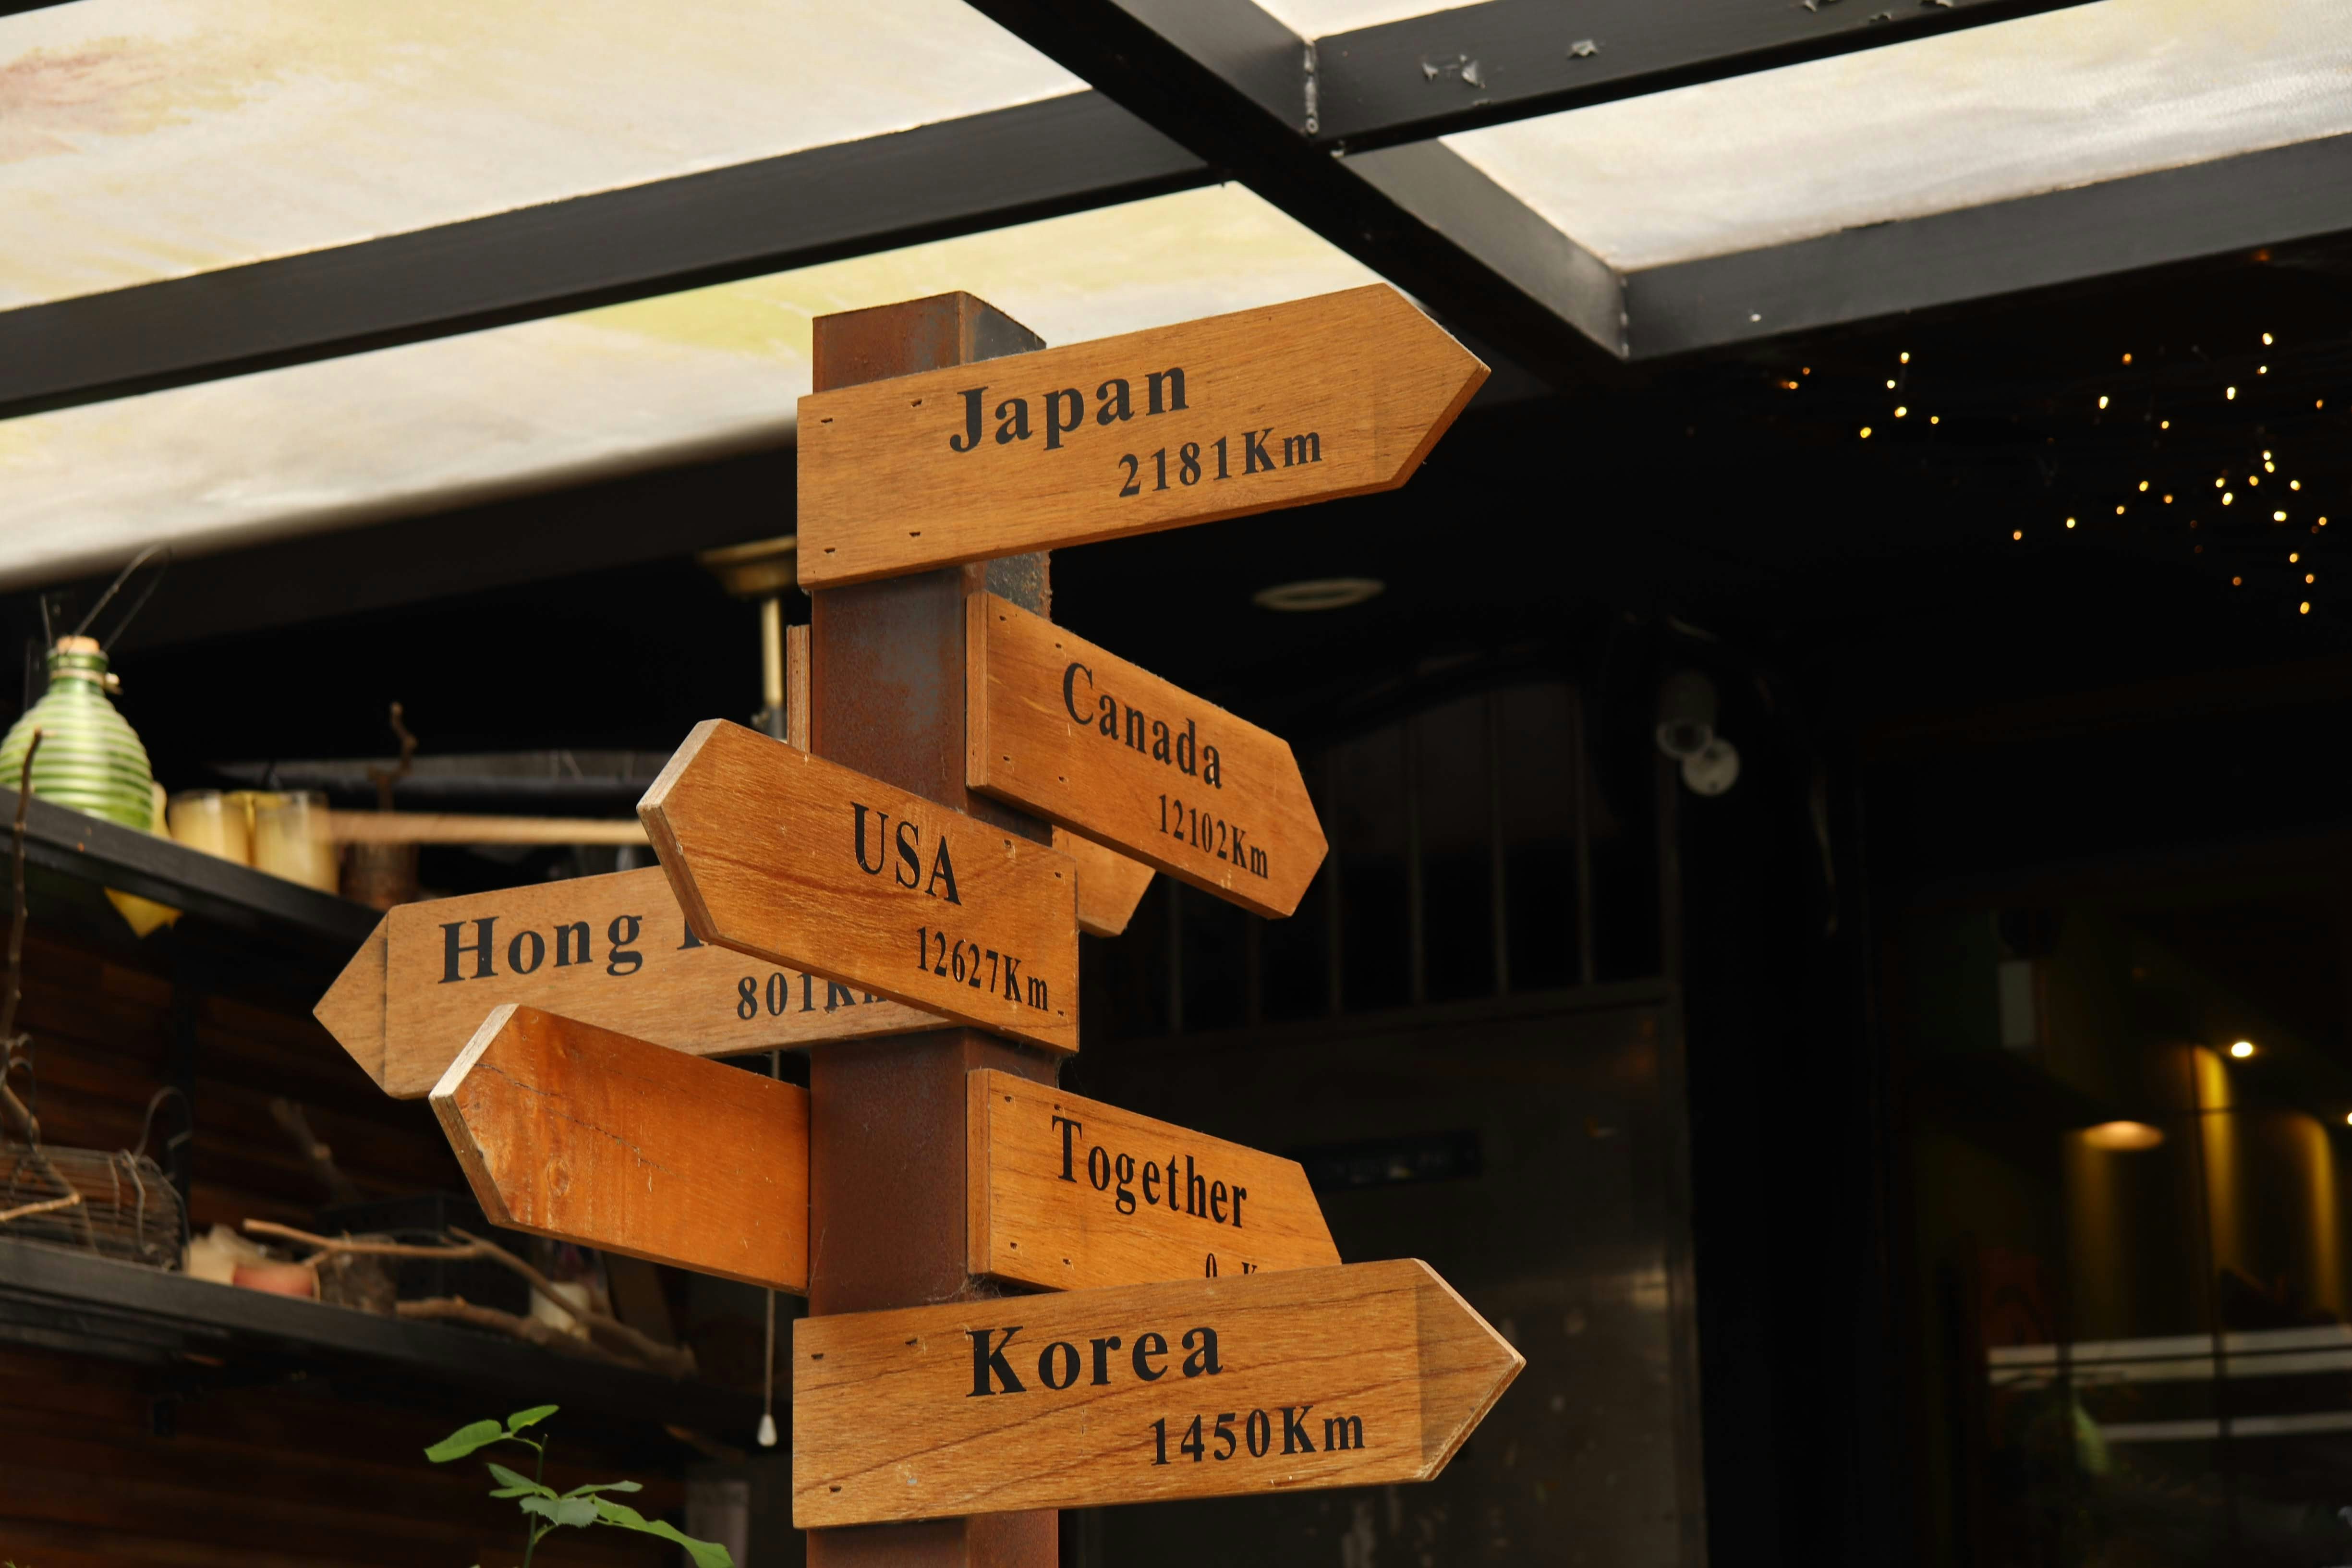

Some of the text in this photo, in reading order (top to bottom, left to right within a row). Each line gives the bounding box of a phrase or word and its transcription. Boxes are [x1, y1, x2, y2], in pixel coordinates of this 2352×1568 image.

[950, 366, 1189, 452] Japan
[1119, 427, 1322, 498] 2181Km
[1063, 662, 1222, 789] Canada
[850, 801, 962, 906] USA
[1159, 794, 1269, 879] 12102Km
[438, 914, 643, 984] Hong
[916, 926, 1048, 1012] 12627Km
[737, 971, 887, 1021] 801K
[1052, 1115, 1247, 1228] Together
[965, 1325, 1224, 1398] Korea
[1149, 1405, 1366, 1466] 1450Km
